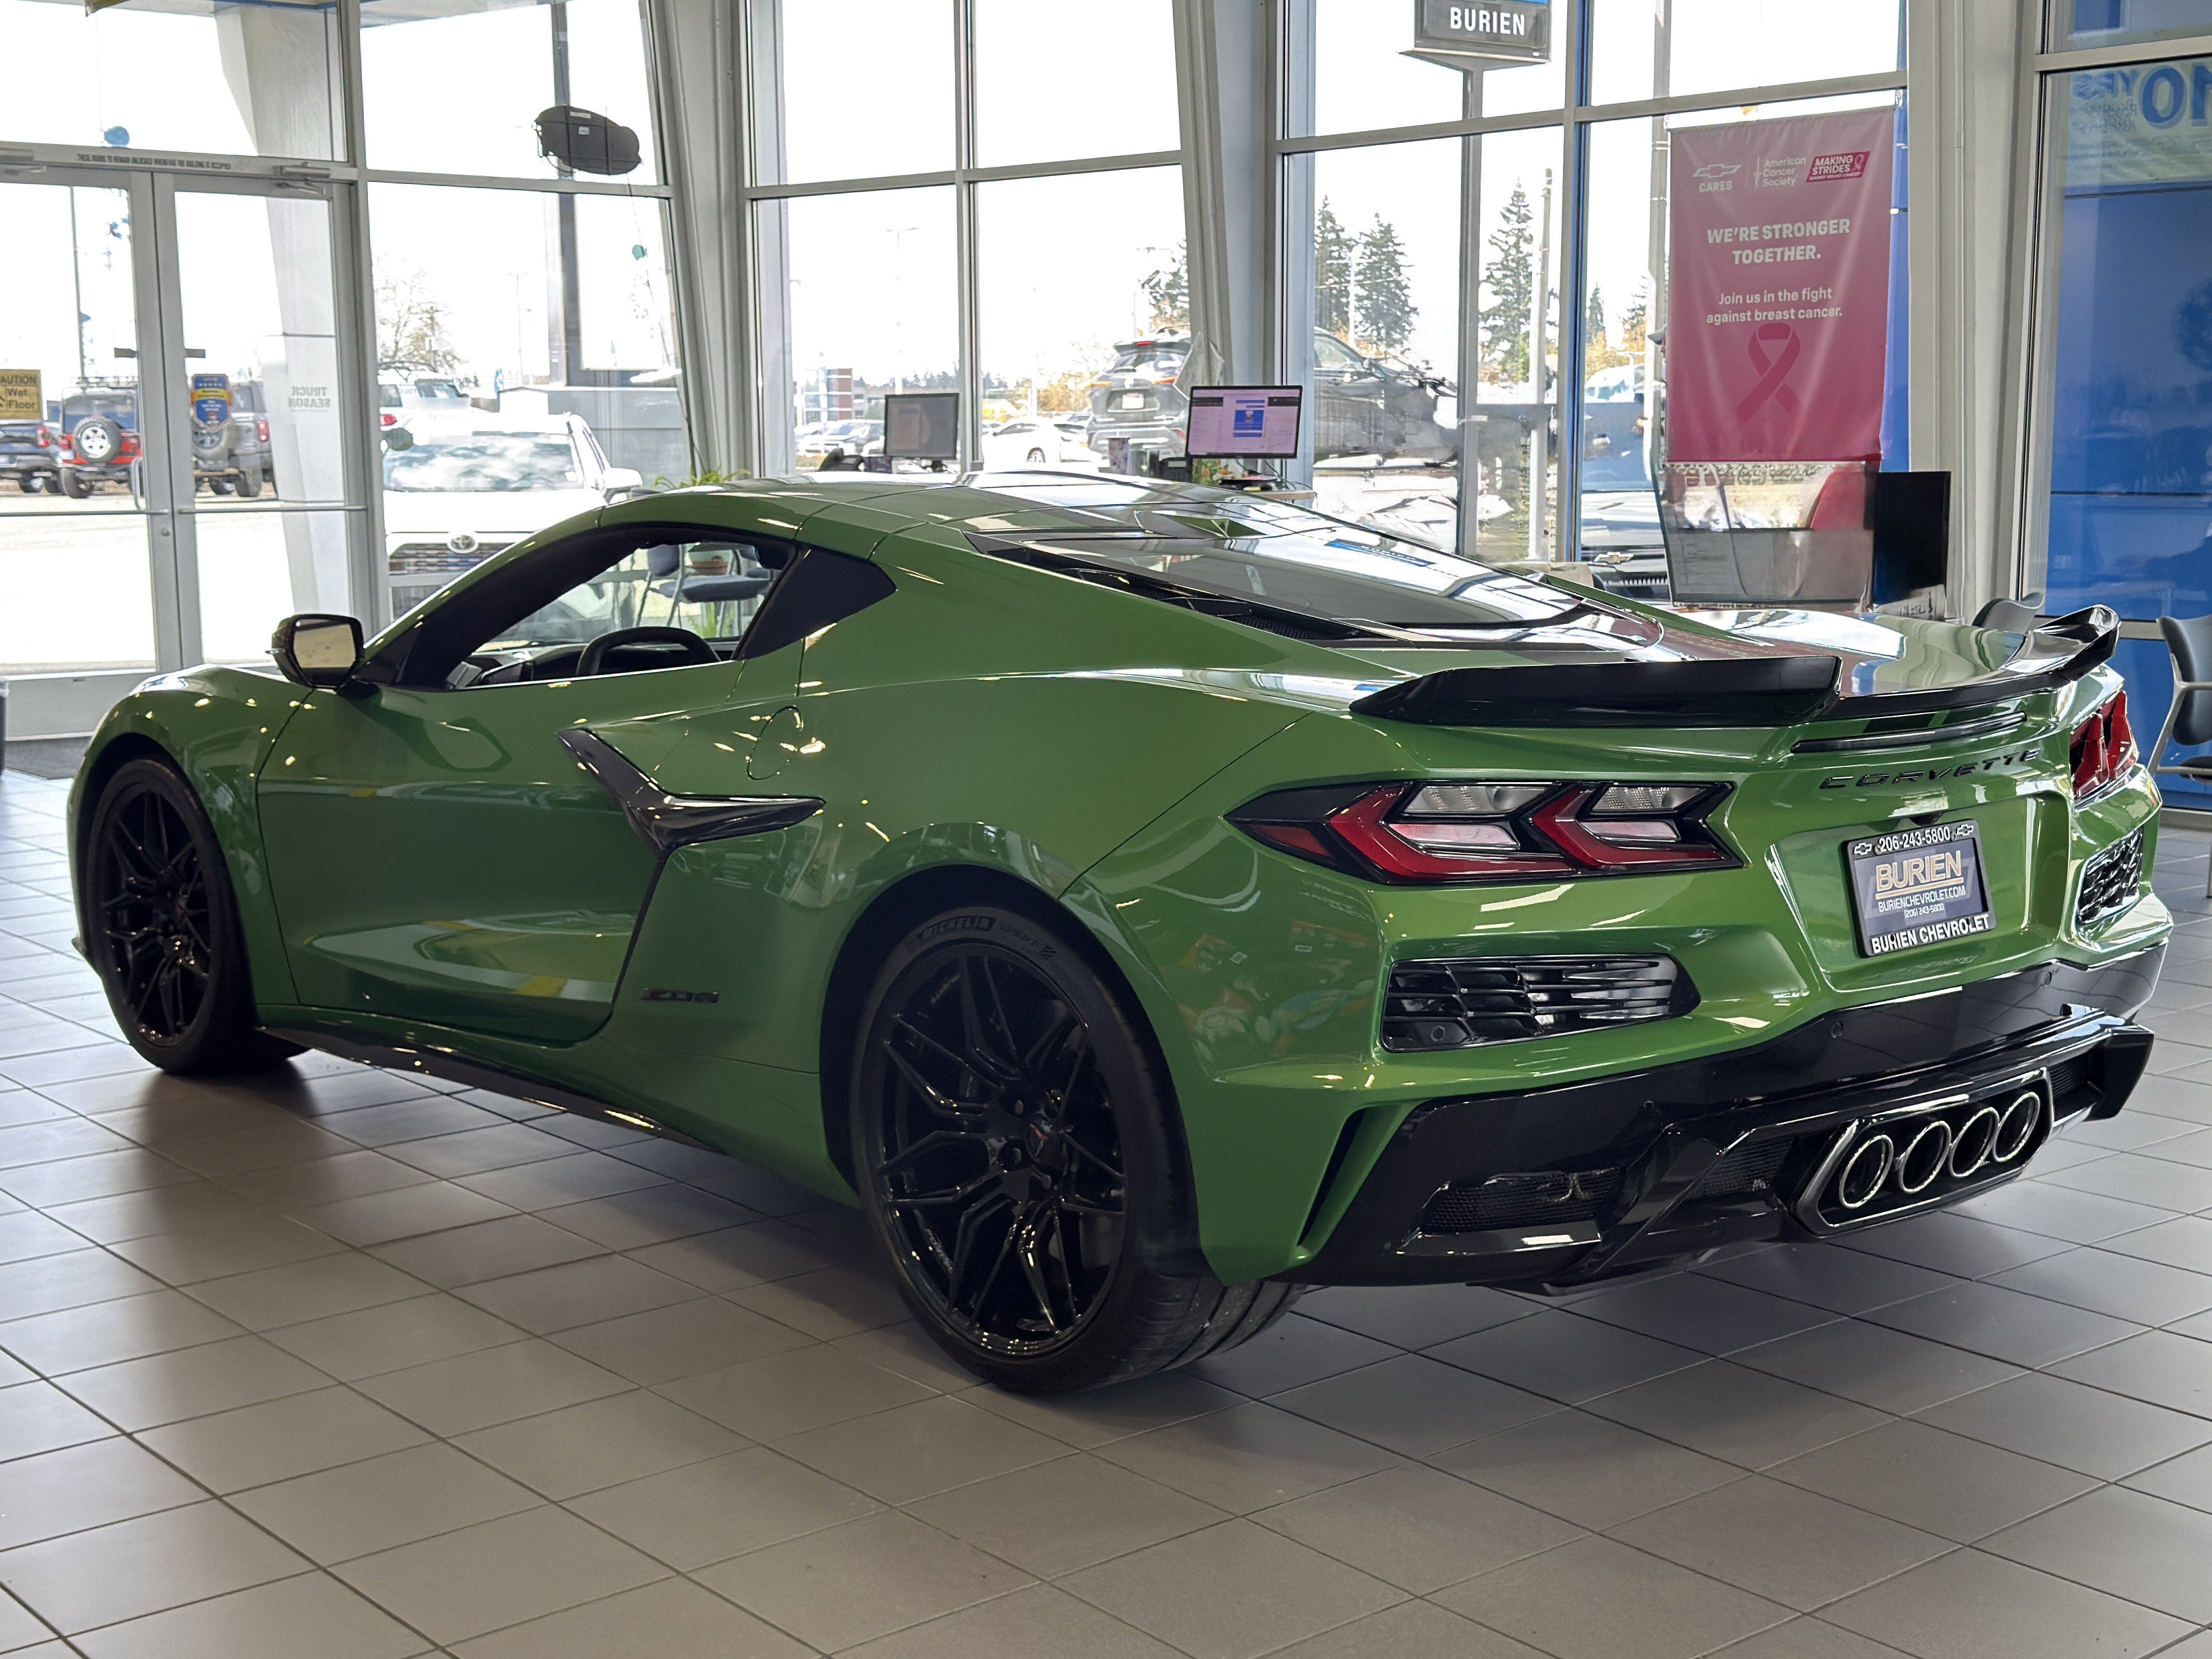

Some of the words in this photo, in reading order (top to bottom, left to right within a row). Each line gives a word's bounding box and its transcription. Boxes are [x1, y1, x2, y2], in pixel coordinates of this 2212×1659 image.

[1450, 7, 1525, 36] BURIEN
[1763, 157, 1807, 168] American
[1812, 163, 1851, 176] STRIDES
[1815, 155, 1854, 167] MAKING
[1763, 168, 1796, 177] Cancer
[1699, 180, 1733, 193] CARES
[1763, 177, 1797, 188] Society
[1707, 226, 1759, 244] WE'RE
[1762, 218, 1851, 240] STRONGER
[1732, 245, 1822, 265] TOGETHER.
[1719, 292, 1743, 305] Join
[1746, 293, 1761, 304] us
[1763, 290, 1775, 303] in
[1778, 288, 1799, 302] the
[1801, 286, 1833, 303] fight
[1706, 310, 1752, 326] against
[1754, 308, 1796, 321] breast
[1798, 307, 1842, 319] cancer.
[0, 375, 37, 385] AUTION
[8, 388, 28, 397] Wet
[8, 399, 36, 409] Floor
[1819, 747, 2041, 789] CORVETTE
[1878, 825, 1951, 853] 206-243-5800
[1875, 850, 1962, 892] BURIEN
[1877, 885, 1966, 913] BURIENCHEVROLET.COM
[1919, 902, 1945, 915] 243-5800
[1919, 913, 1989, 944] CHEVROLET
[1871, 928, 1918, 954] BURIEN
